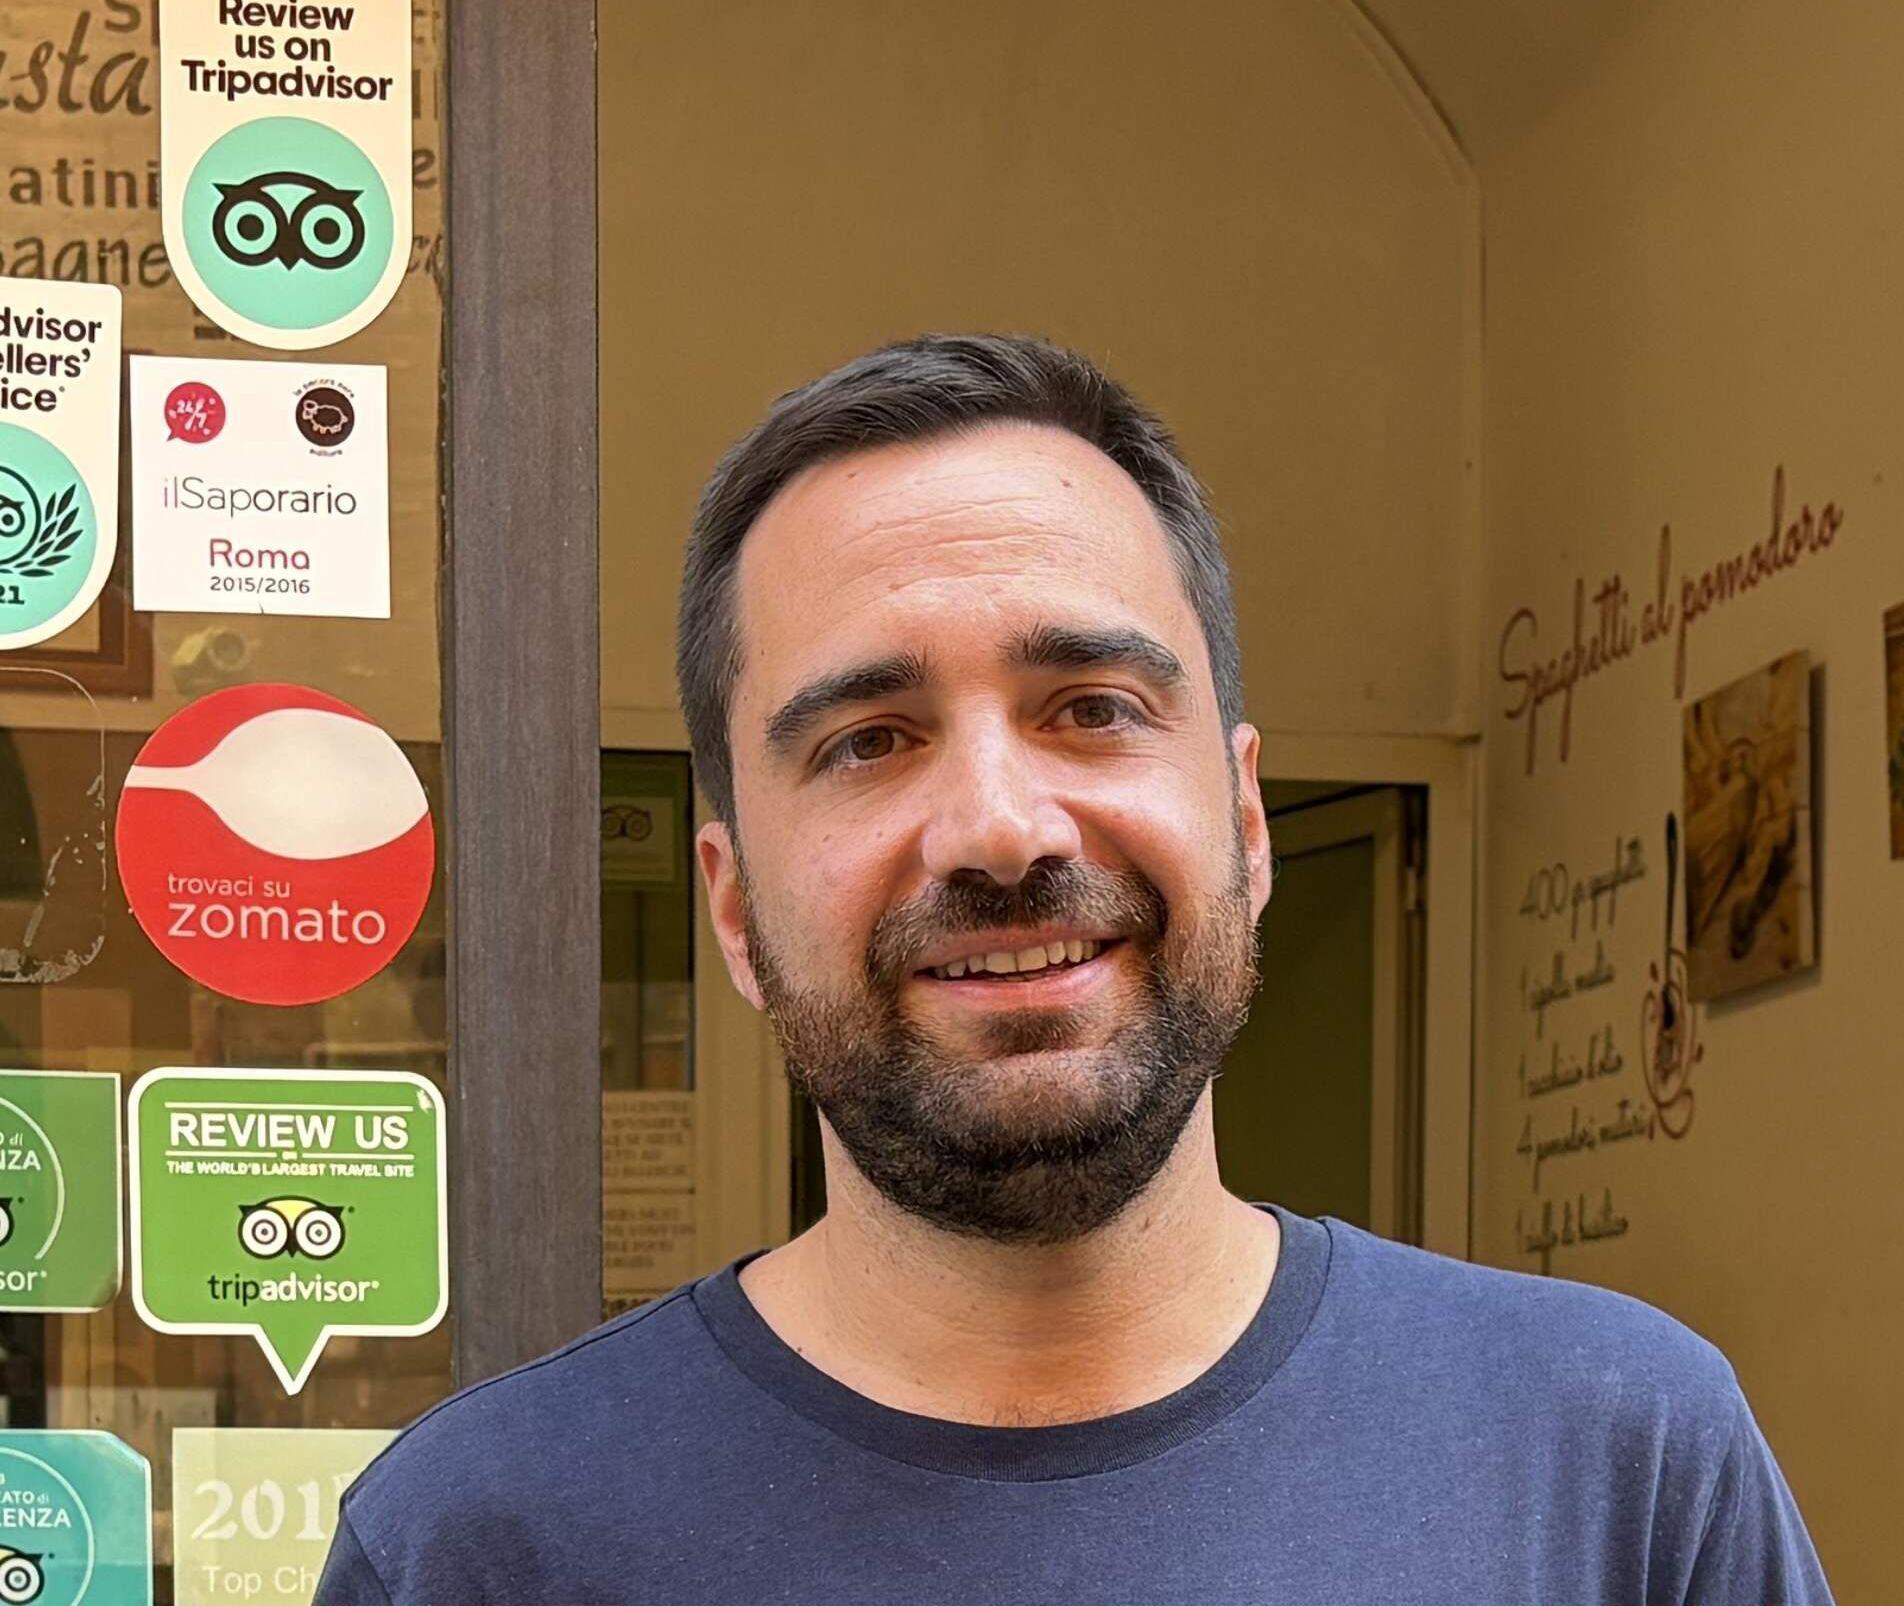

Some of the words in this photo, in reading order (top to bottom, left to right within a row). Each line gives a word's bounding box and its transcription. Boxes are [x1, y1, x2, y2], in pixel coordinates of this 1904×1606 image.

[219, 0, 354, 31] Review
[234, 34, 275, 59] us
[284, 36, 331, 62] on
[180, 59, 393, 101] Tripadvisor
[163, 476, 357, 519] ilSaporario
[209, 538, 310, 570] Roma
[210, 576, 310, 594] 2015/2016
[167, 872, 254, 896] trovaci
[263, 879, 291, 898] su
[167, 899, 386, 945] zomato
[9, 1132, 24, 1146] di
[169, 1112, 336, 1148] REVIEW
[354, 1115, 409, 1150] US
[166, 1160, 195, 1174] THE
[197, 1161, 261, 1176] WORLD'S
[263, 1162, 326, 1177] LARGEST
[329, 1163, 381, 1177] TRAVEL
[384, 1164, 415, 1178] SITE
[207, 1272, 368, 1307] tripadvisor
[201, 1565, 262, 1600] Top
